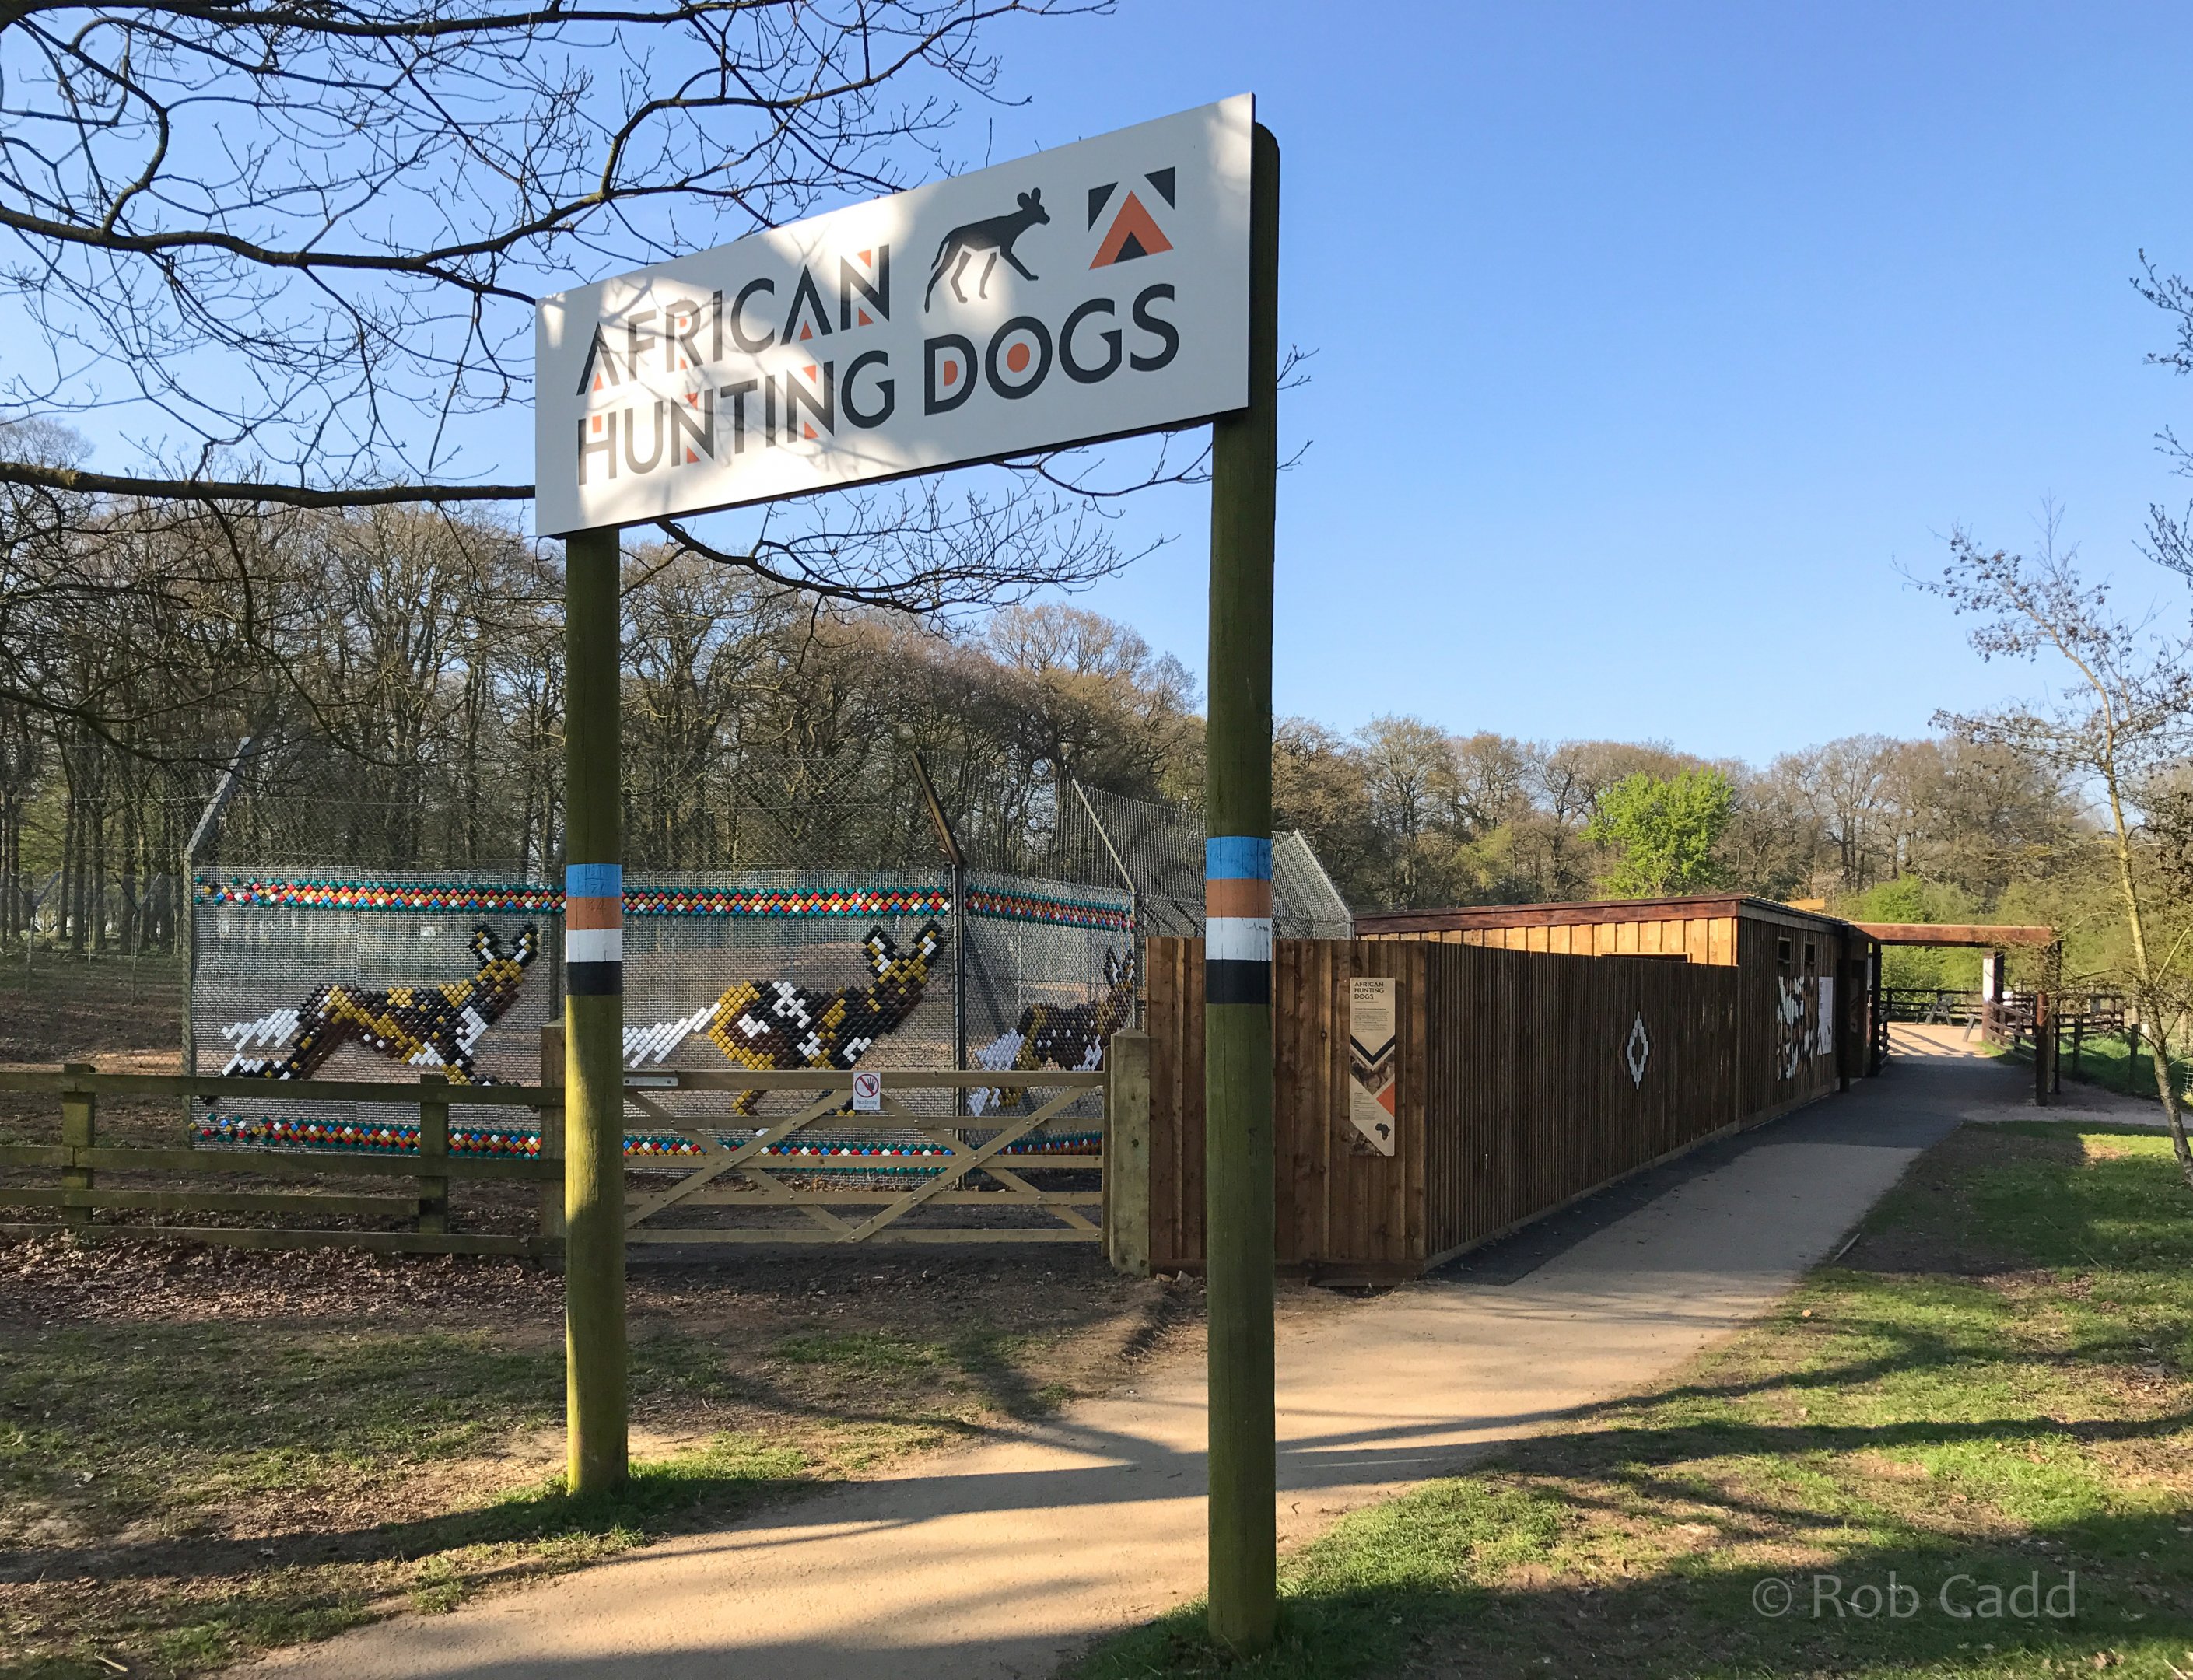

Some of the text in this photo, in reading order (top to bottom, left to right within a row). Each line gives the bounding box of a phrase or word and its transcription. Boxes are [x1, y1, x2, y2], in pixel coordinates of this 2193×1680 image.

[576, 244, 890, 396] AFRICAN
[577, 283, 1179, 486] HUNTING DOGS
